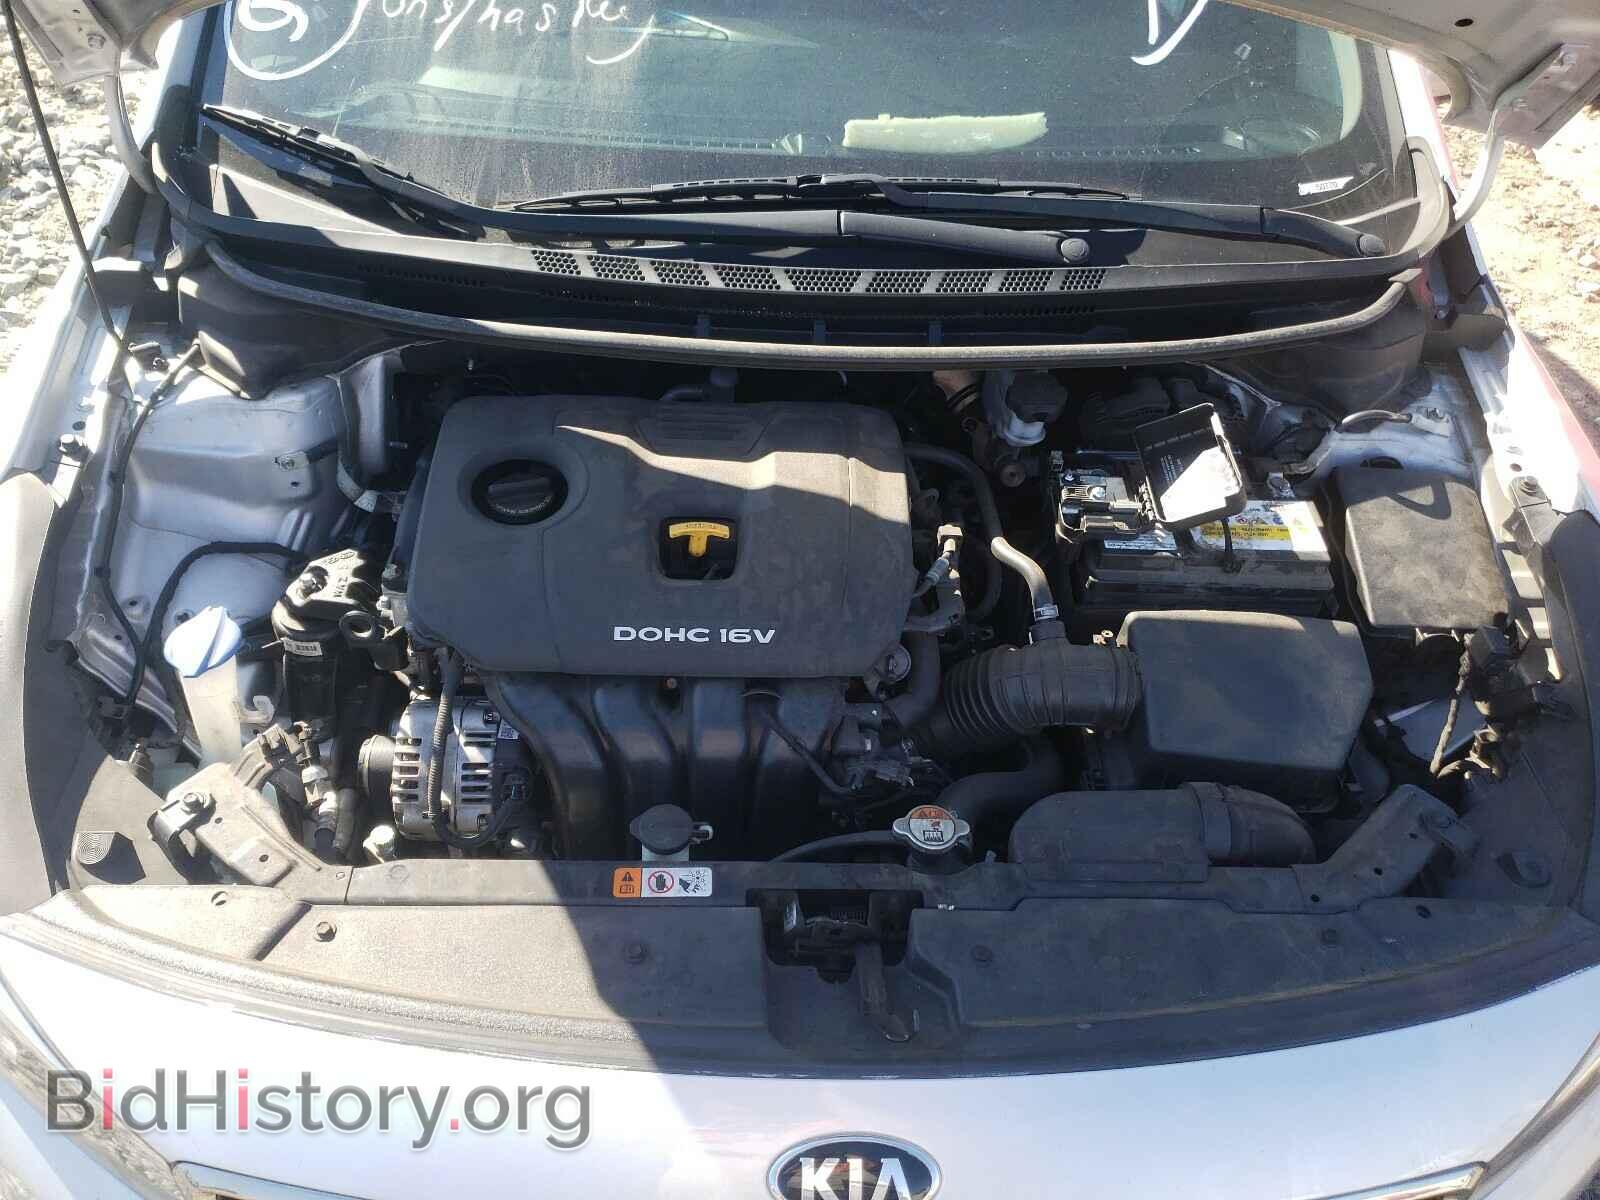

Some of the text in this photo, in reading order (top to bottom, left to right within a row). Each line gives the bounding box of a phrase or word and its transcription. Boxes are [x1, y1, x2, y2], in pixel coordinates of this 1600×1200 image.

[613, 626, 776, 644] DOHC 16V
[799, 1157, 913, 1200] KIA
